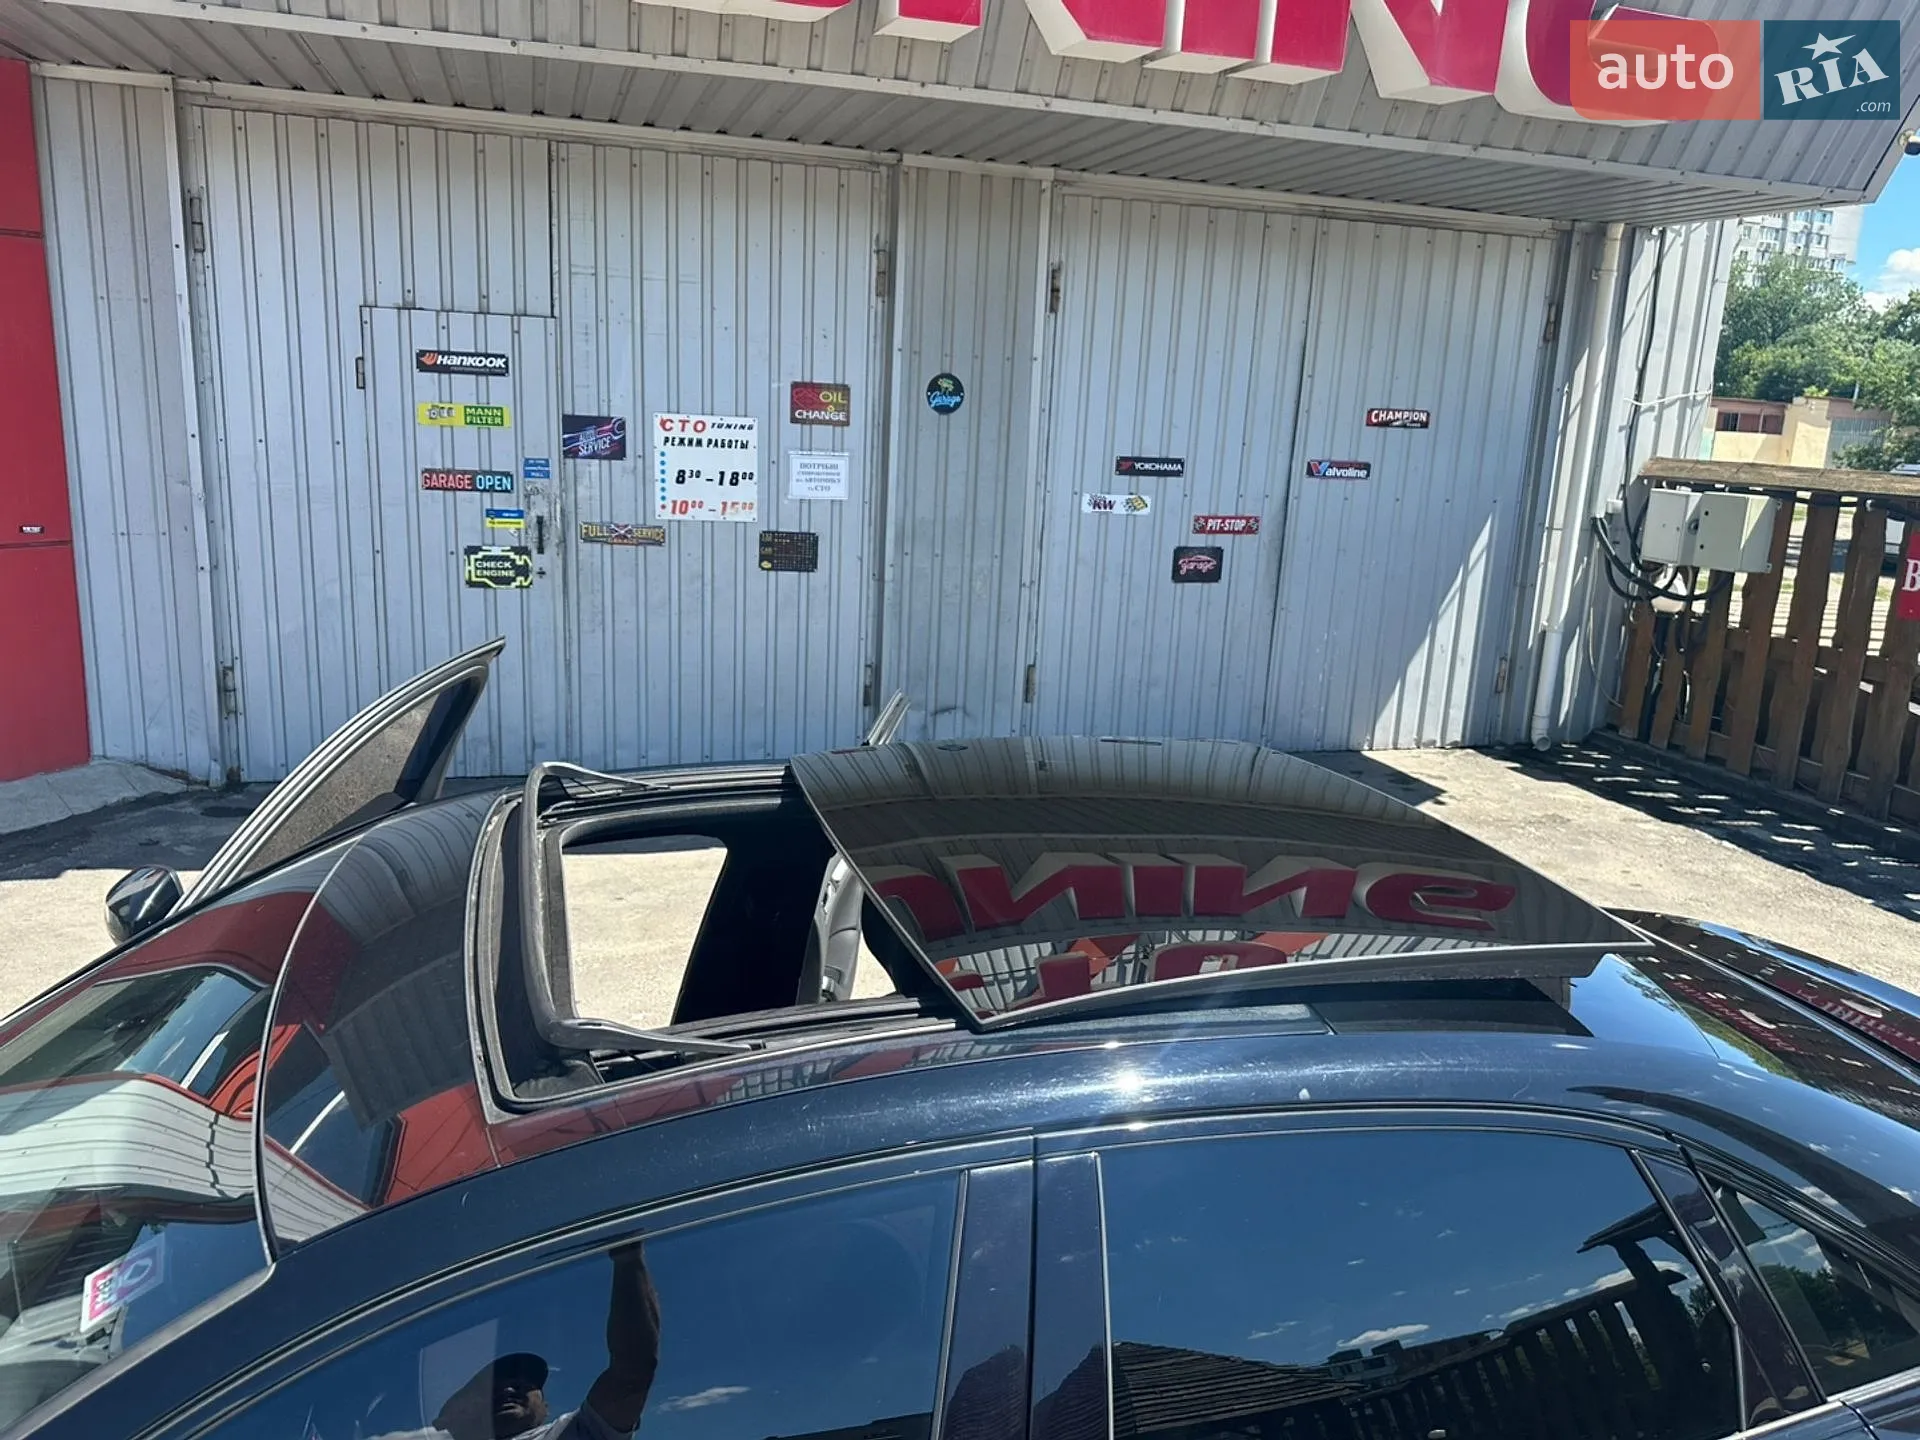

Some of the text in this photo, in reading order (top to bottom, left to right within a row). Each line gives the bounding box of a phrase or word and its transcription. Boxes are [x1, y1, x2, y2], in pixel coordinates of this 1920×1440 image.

[819, 391, 848, 404] OIL
[466, 407, 502, 416] MANN
[794, 409, 847, 421] CHANGE
[1371, 410, 1428, 423] CHAMPION
[466, 416, 502, 424] FILTER
[711, 422, 754, 431] TUNING
[663, 436, 750, 450] РЕЖИМ РАБОТЫ
[1134, 462, 1183, 471] YOKOHAMA
[1310, 461, 1368, 478] Valvoline
[422, 472, 512, 490] GARAGE OPEN
[582, 524, 608, 536] FULL
[1206, 518, 1247, 531] PIT-STOP
[476, 569, 516, 577] ENGINE
